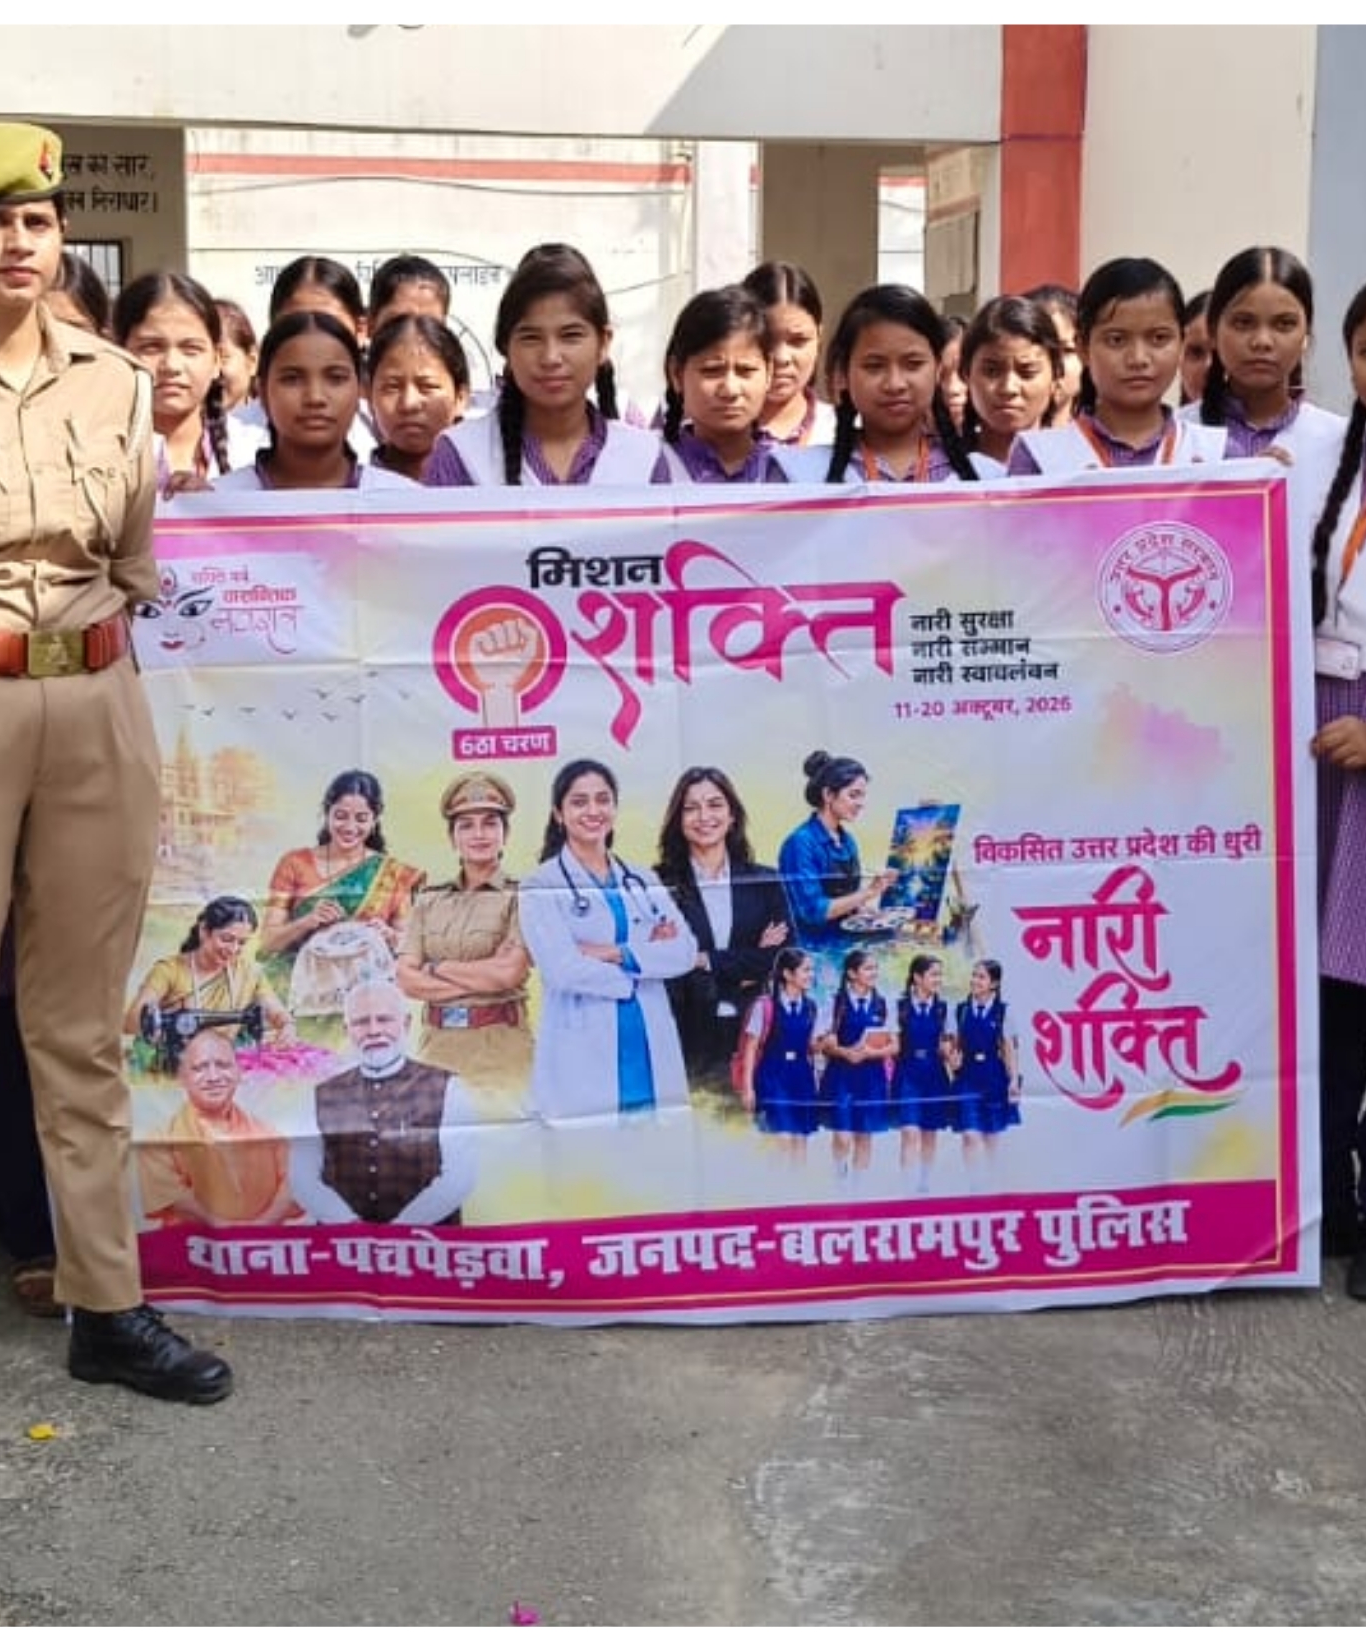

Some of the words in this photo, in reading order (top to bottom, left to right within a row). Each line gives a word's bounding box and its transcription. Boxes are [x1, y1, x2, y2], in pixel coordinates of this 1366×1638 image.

[526, 546, 665, 589] मिशन
[909, 608, 952, 632] नारी
[959, 610, 1014, 636] सुरक्षा
[570, 539, 906, 750] शक्ति
[910, 636, 952, 658] नारी
[959, 637, 1031, 657] सम्मान
[910, 661, 953, 684] नारी
[960, 658, 1059, 683] स्वावलंबन
[895, 701, 945, 719] 11-20
[1026, 696, 1072, 714] 2026
[501, 732, 550, 753] चरण
[973, 831, 1063, 863] विकसित
[1071, 836, 1118, 860] उत्तर
[1125, 827, 1179, 858] प्रदेश
[1185, 824, 1215, 855] की
[1223, 823, 1262, 859] धुरी
[1011, 864, 1172, 992] नारी
[1032, 971, 1242, 1111] शक्ति
[581, 1210, 1026, 1279] जनपद-बलरामपुर
[1034, 1194, 1191, 1268] पुलिस
